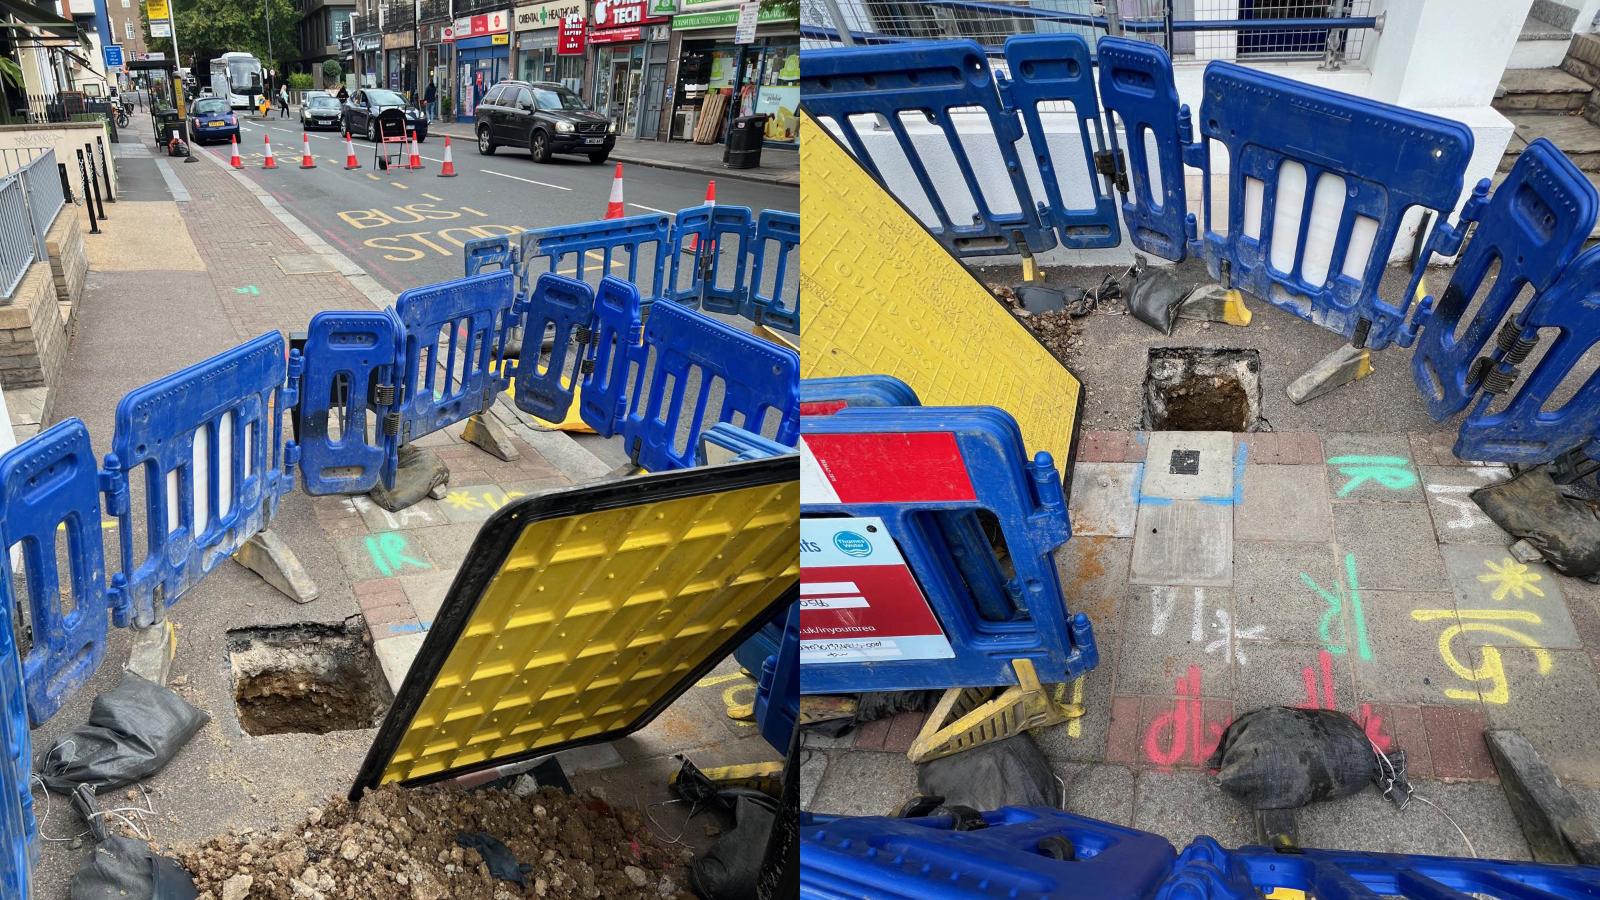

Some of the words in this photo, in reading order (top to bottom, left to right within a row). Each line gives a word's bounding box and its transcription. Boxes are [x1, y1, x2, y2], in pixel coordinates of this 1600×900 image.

[518, 12, 540, 24] ORIENTAL
[548, 5, 580, 20] HEALTHCARE
[613, 5, 641, 24] TECH
[337, 203, 462, 229] BUS
[363, 224, 520, 262] STOP
[832, 259, 904, 318] 15/10
[872, 319, 938, 373] Oxford
